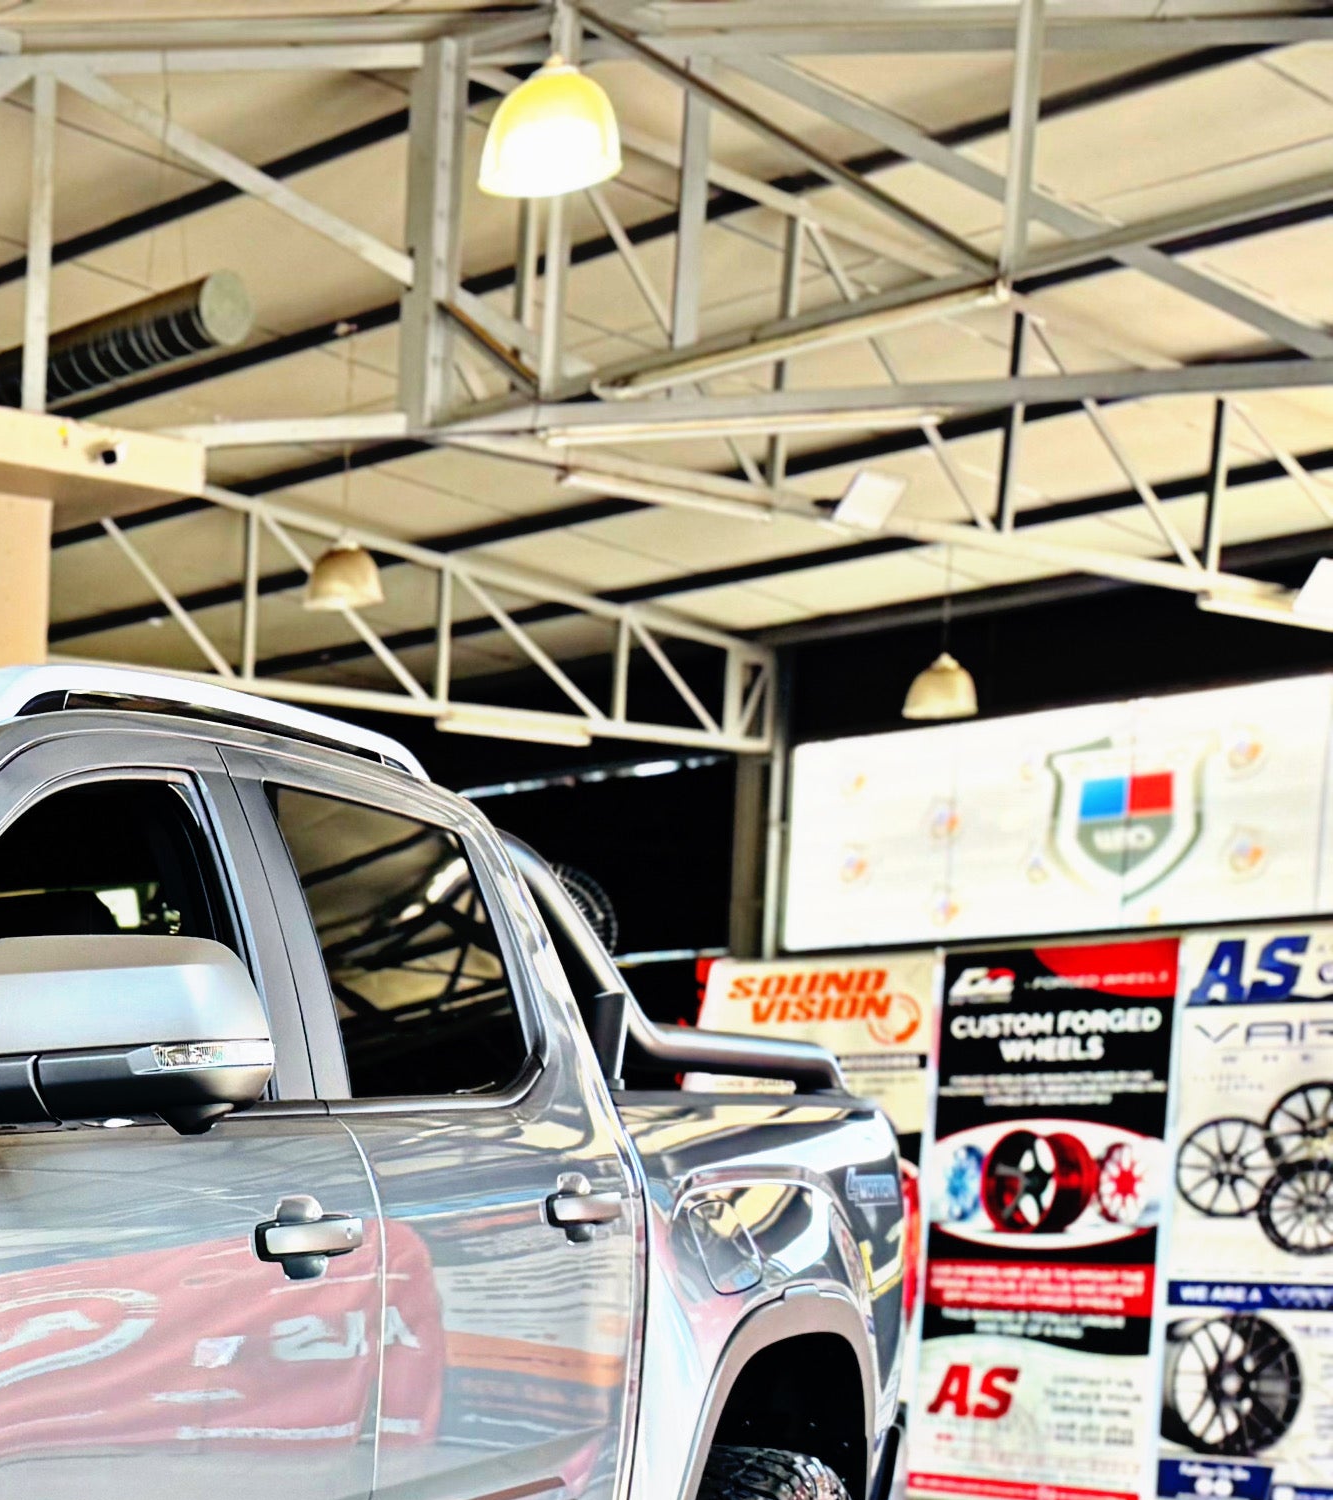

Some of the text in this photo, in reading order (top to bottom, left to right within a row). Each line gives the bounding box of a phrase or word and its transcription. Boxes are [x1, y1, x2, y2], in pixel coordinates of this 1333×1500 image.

[728, 969, 888, 1000] SOUND
[1185, 935, 1311, 1007] AS
[752, 994, 892, 1025] VISION
[950, 1006, 1163, 1040] CUSTOM FORGED
[998, 1034, 1106, 1062] WHEELS
[926, 1363, 1021, 1420] AS
